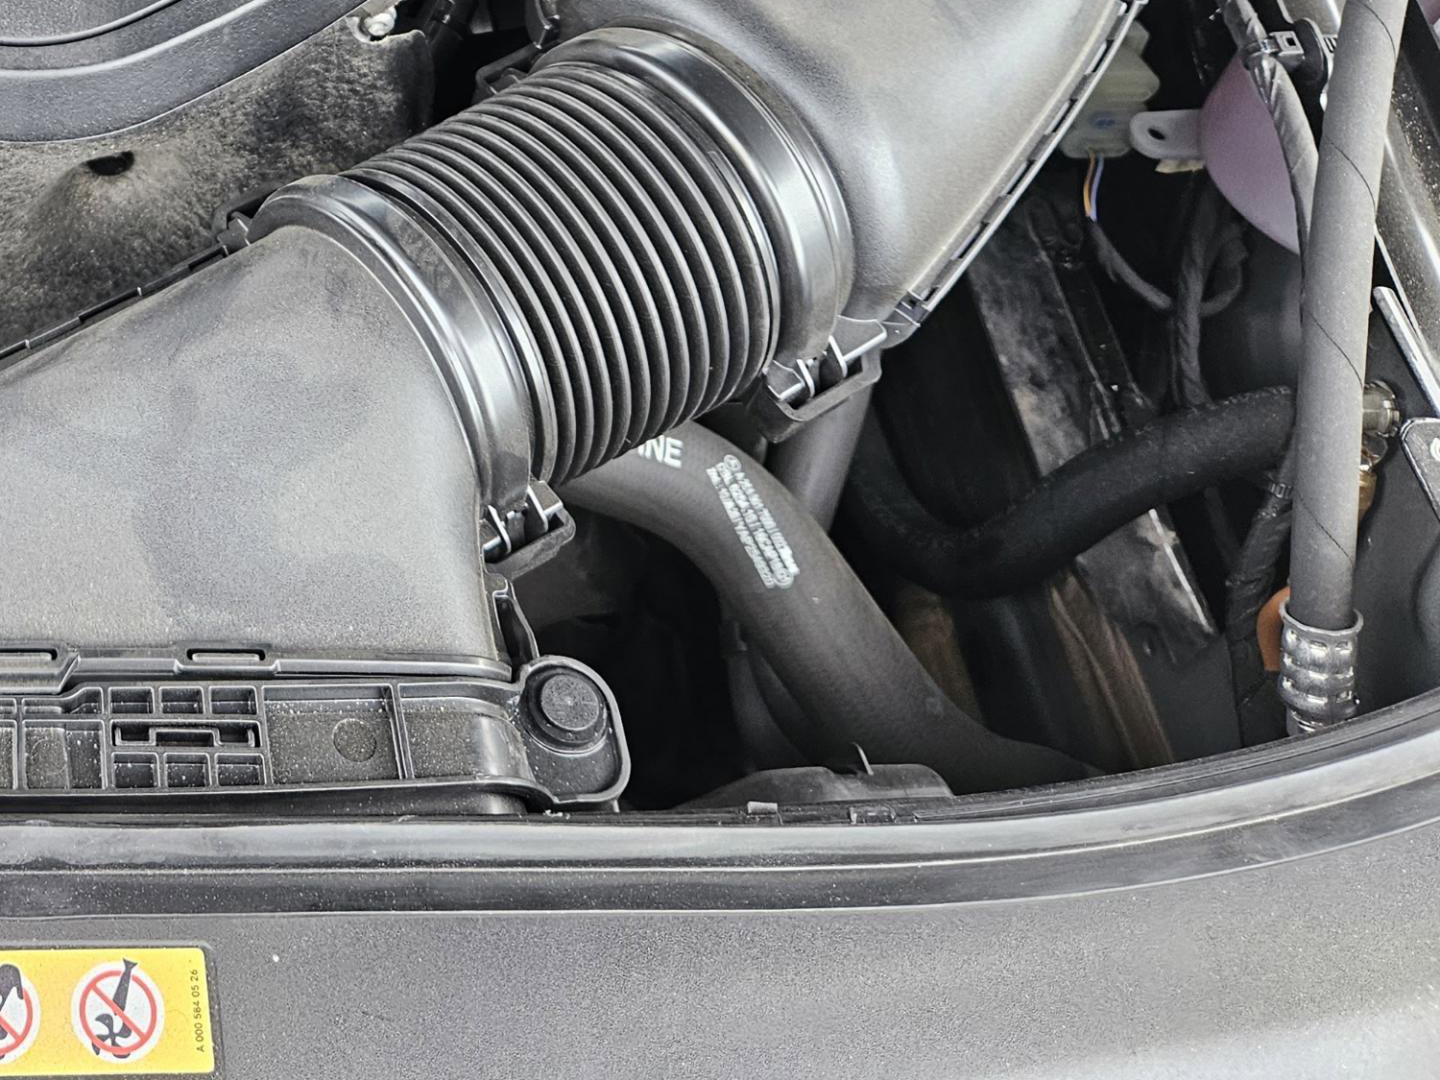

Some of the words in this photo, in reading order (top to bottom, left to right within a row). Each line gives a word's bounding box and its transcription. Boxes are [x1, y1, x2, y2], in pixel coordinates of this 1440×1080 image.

[190, 969, 199, 981] 26
[191, 984, 200, 998] 05
[194, 1022, 204, 1042] 000
[196, 1044, 205, 1053] A
